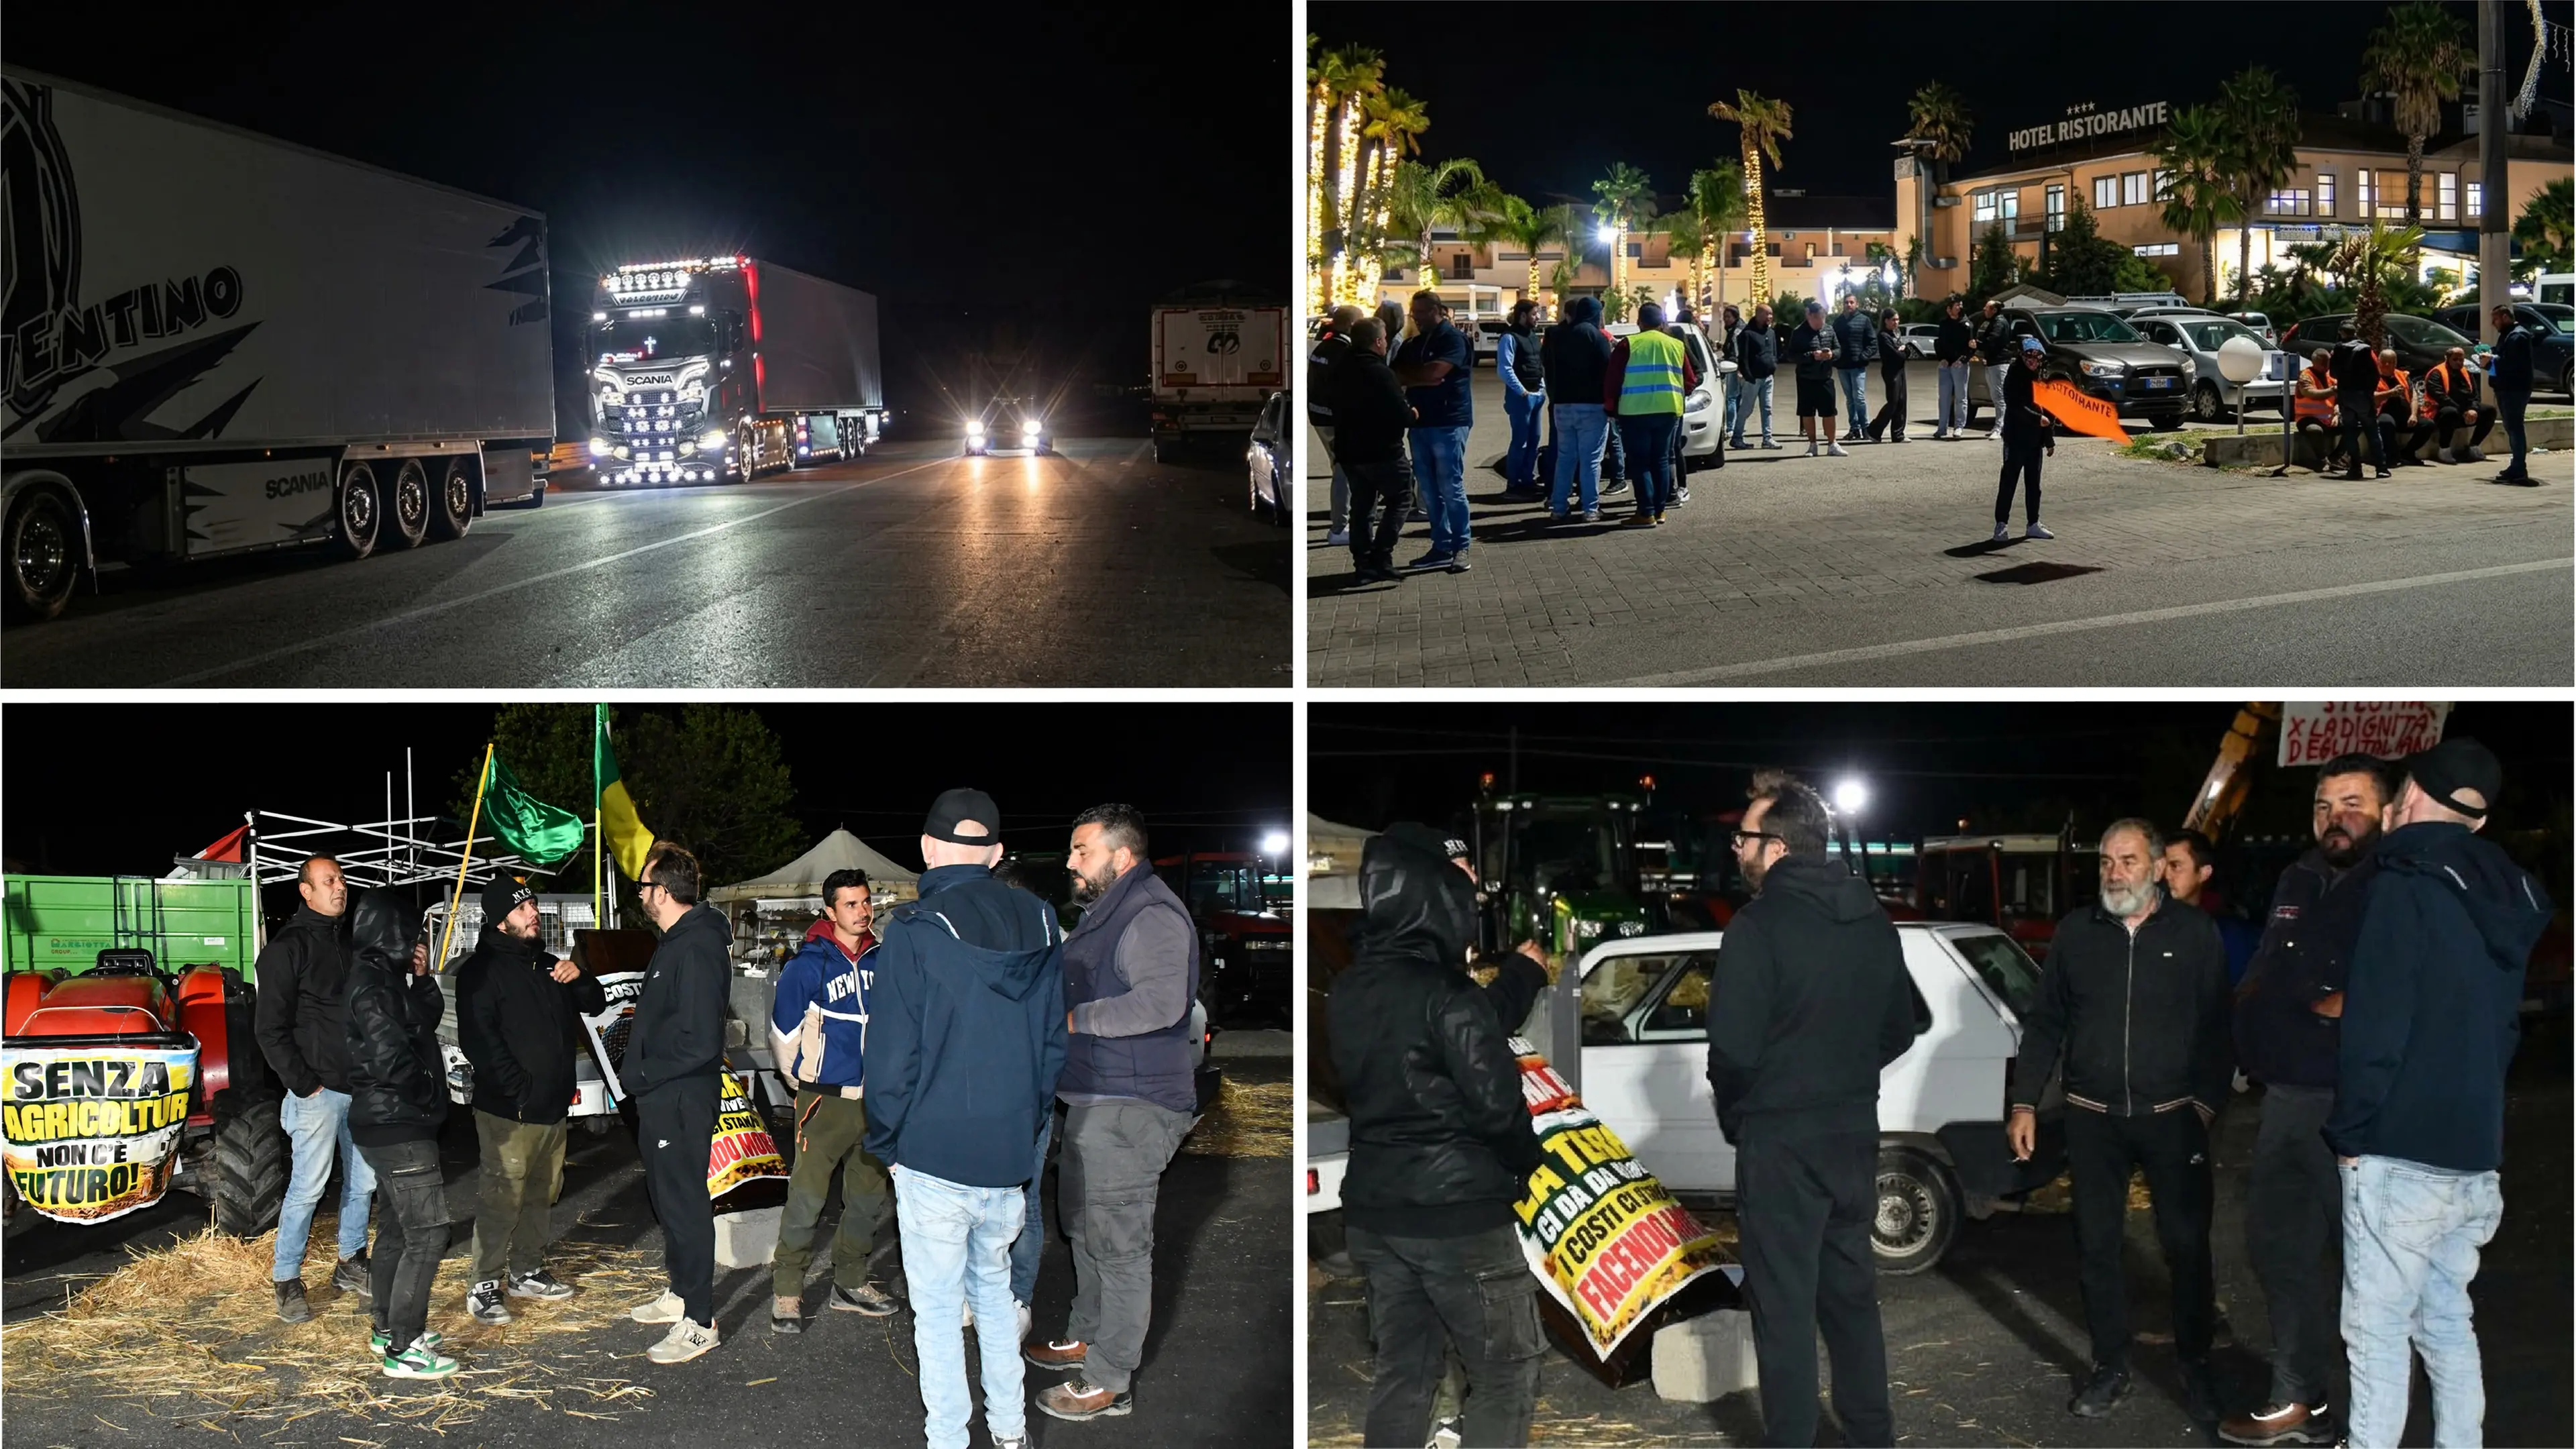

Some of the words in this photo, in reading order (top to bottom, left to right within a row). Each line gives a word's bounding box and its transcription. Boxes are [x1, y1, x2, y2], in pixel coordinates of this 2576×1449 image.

[2009, 125, 2055, 150] HOTEL
[2059, 101, 2167, 142] RISTORANTE
[627, 375, 672, 386] SCANIA
[266, 472, 329, 499] SCANIA
[2288, 717, 2305, 737] X
[826, 971, 855, 1004] NEW
[13, 1061, 172, 1099] SENZA
[36, 1144, 87, 1168] NON
[13, 1163, 140, 1205] FUTURO!
[1617, 1191, 1642, 1214] CI
[1537, 1208, 1564, 1244] CI
[1565, 1202, 1623, 1264] COSTI
[1558, 1253, 1574, 1277] I
[1577, 1213, 1681, 1323] FACENDO
